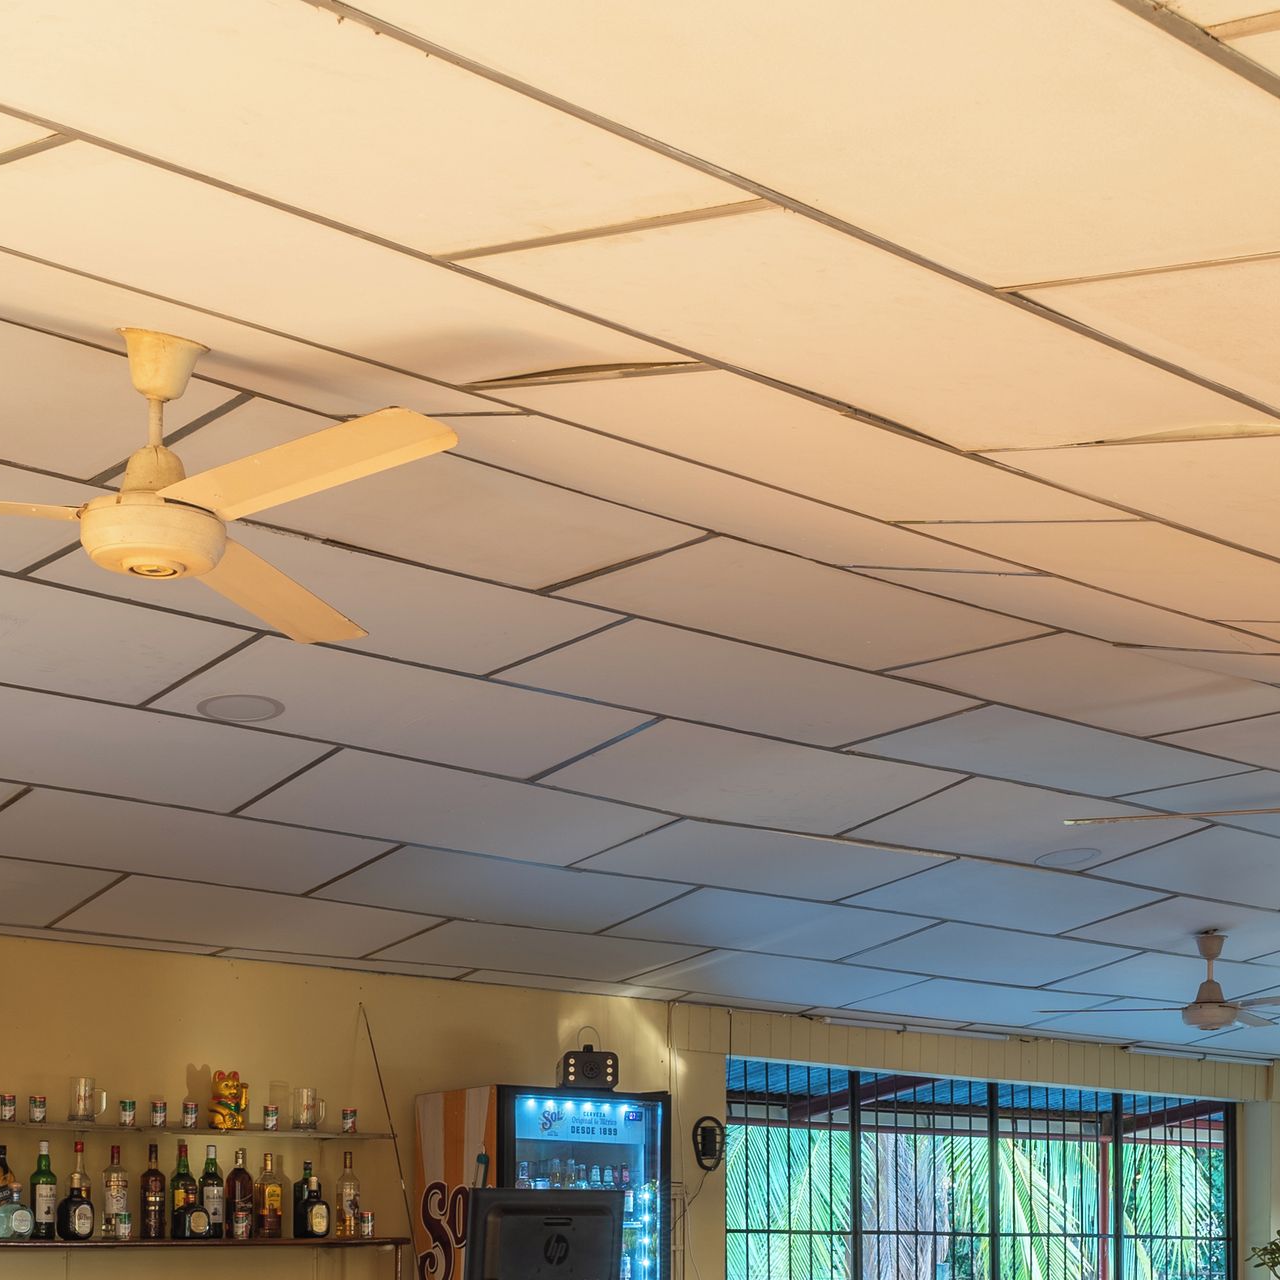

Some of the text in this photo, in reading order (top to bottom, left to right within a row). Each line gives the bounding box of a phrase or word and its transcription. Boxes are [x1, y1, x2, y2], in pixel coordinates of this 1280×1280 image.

[571, 1126, 618, 1136] DESDE 1899
[546, 1233, 568, 1266] hp
